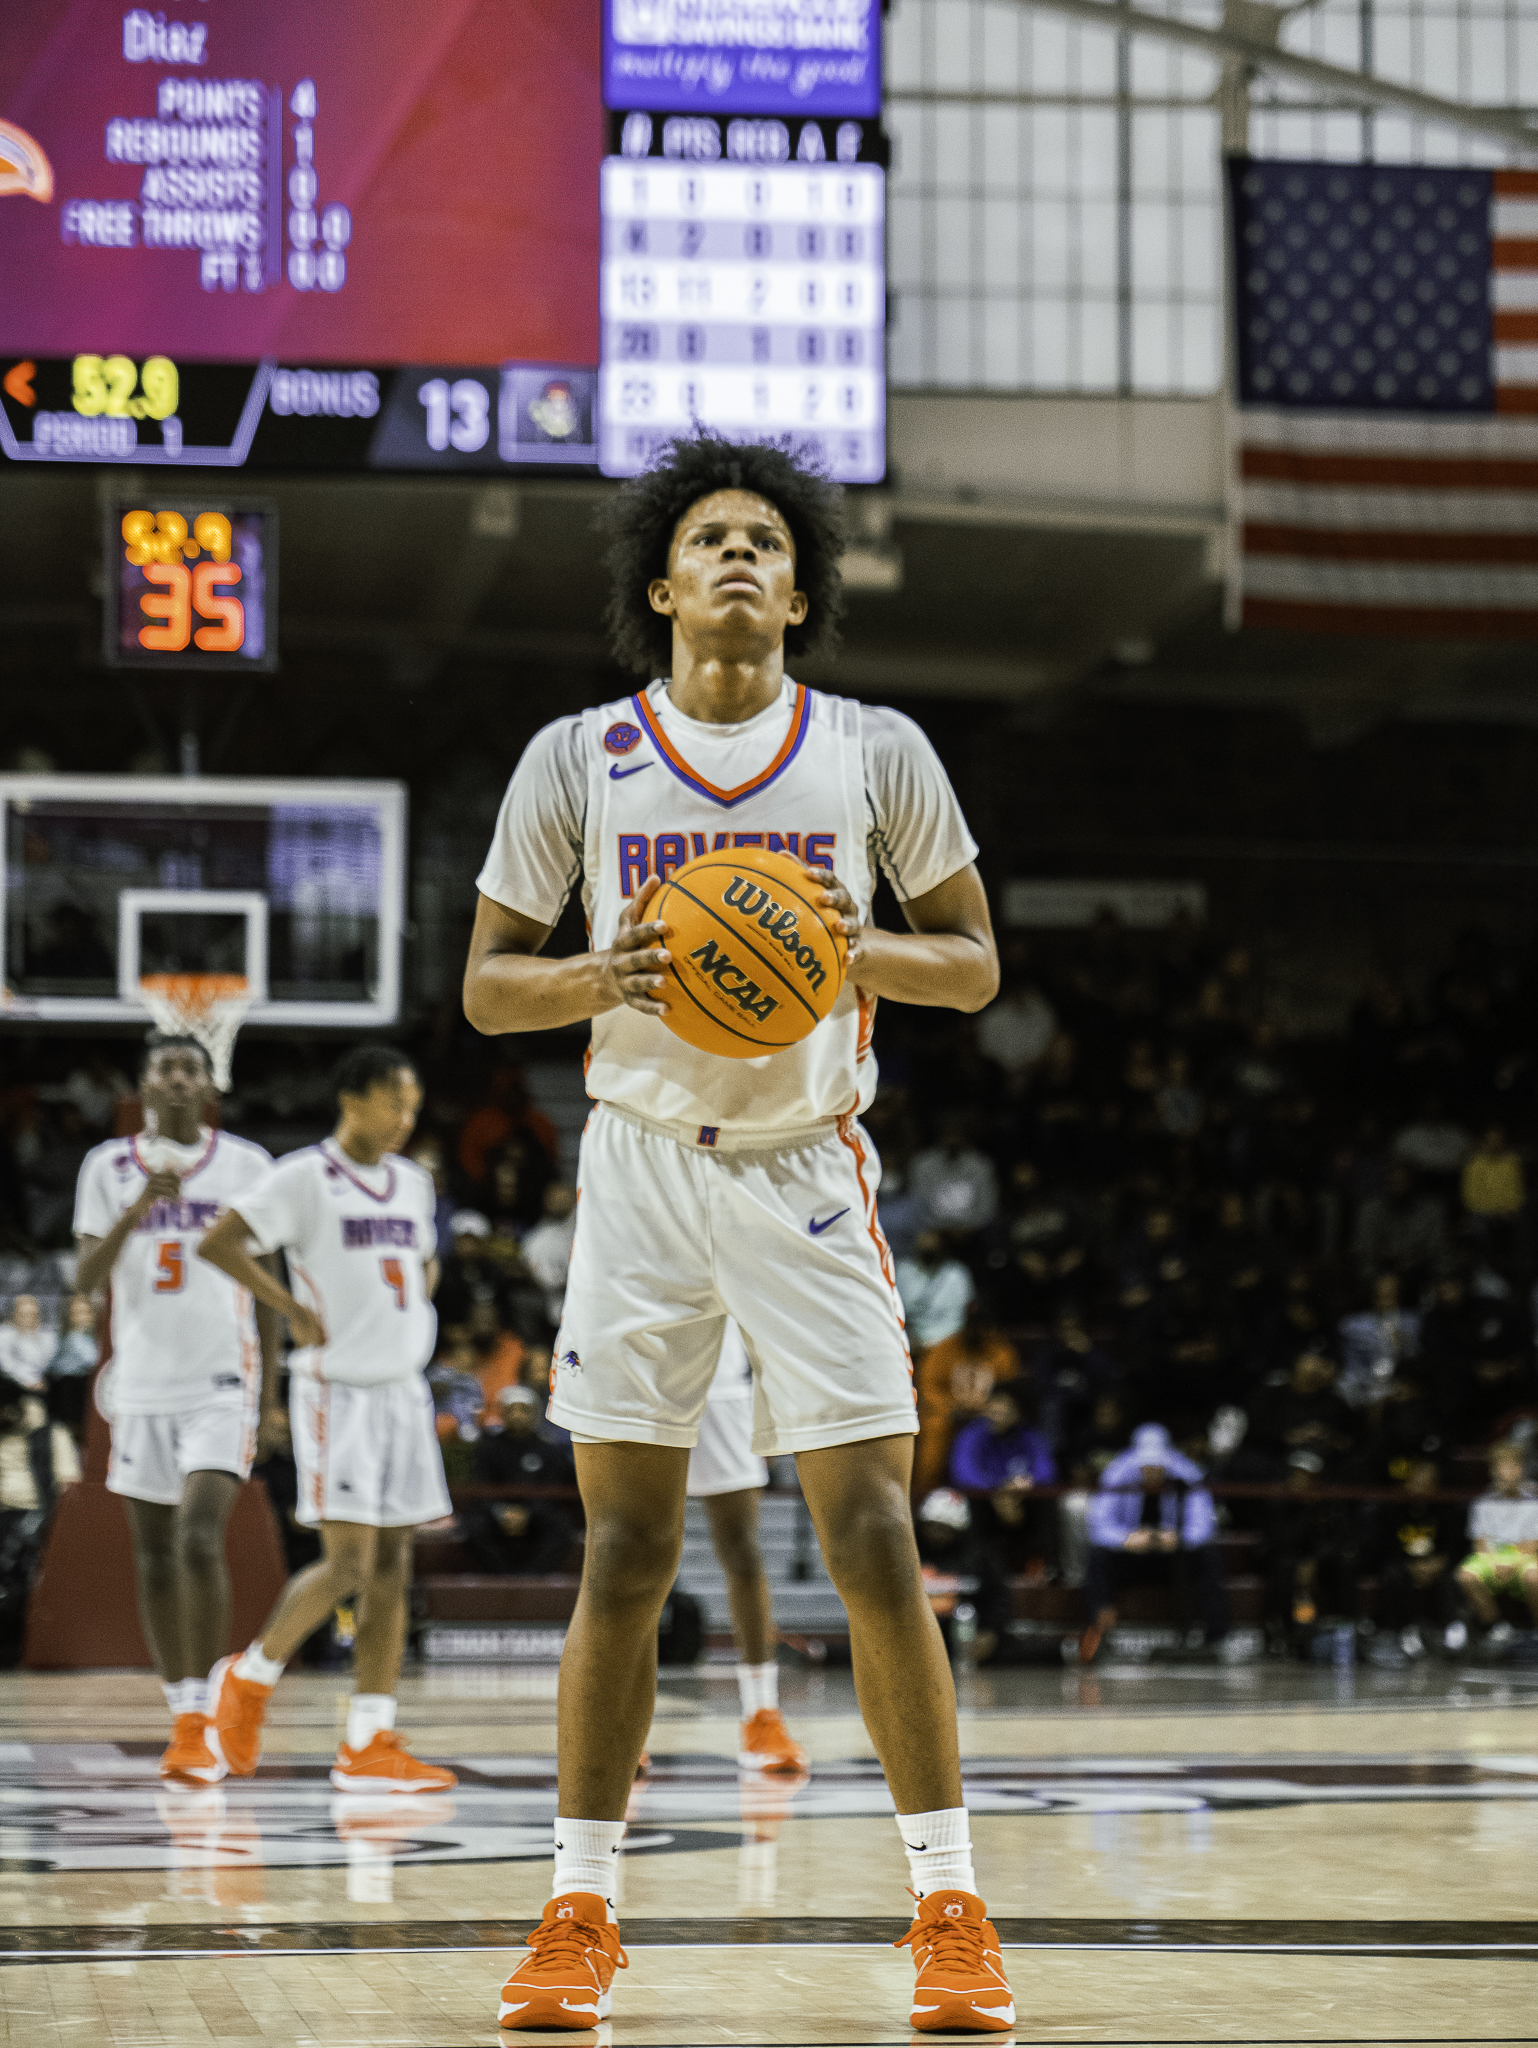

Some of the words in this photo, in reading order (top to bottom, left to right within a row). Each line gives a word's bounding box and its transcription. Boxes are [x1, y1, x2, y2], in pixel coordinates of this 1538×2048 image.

[157, 76, 266, 128] POINTS
[289, 76, 318, 119] 4
[105, 115, 263, 168] REBOUNDS
[140, 164, 263, 211] ASSISTS
[61, 199, 139, 248] FREE
[141, 205, 263, 253] THROWS
[200, 250, 240, 293] FT
[71, 353, 179, 419] 52.9
[271, 369, 380, 418] BONUS
[419, 378, 490, 452] 13
[138, 561, 245, 652] 35
[618, 833, 836, 899] RAS
[721, 875, 827, 994] Wilson
[689, 938, 780, 1023] NCAA
[152, 1241, 184, 1294] 5
